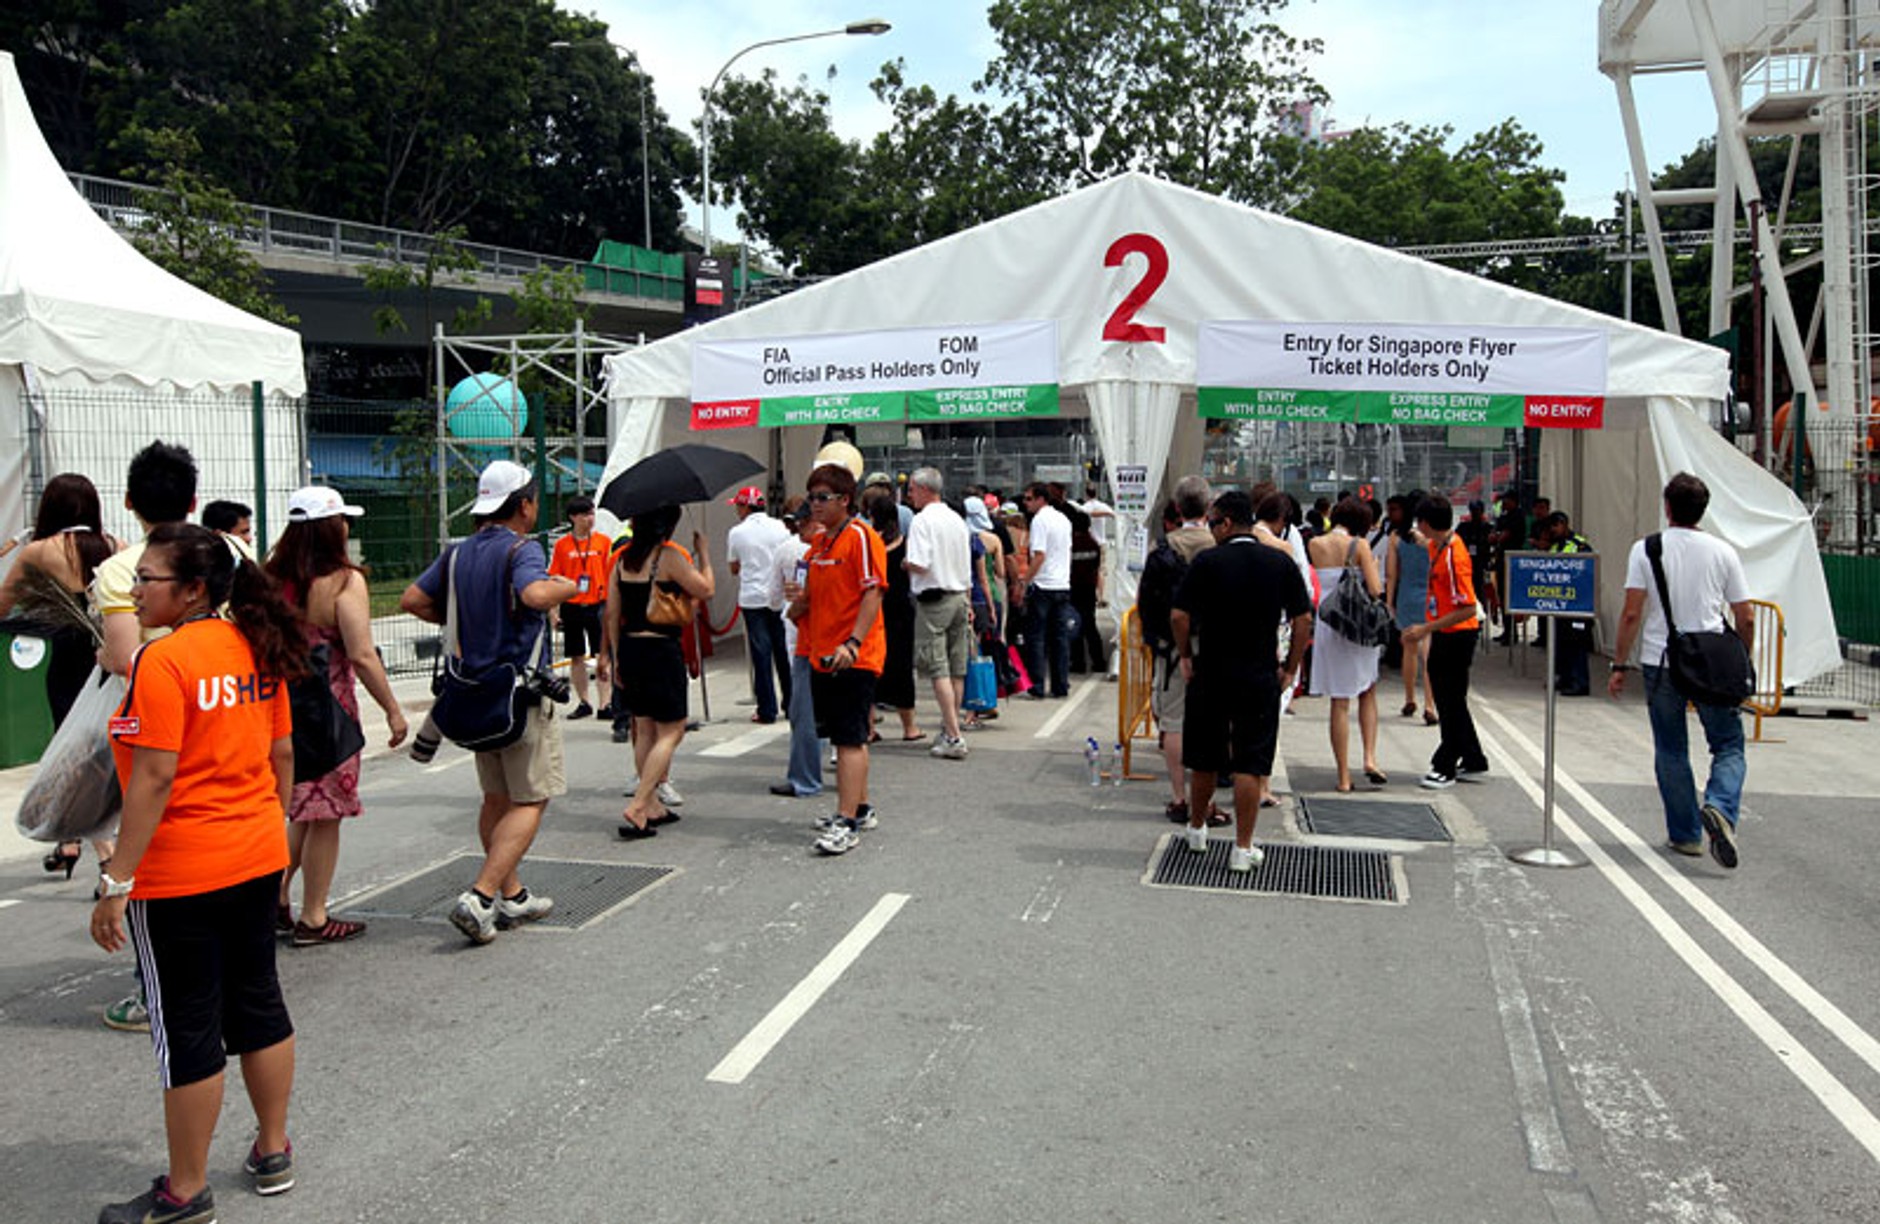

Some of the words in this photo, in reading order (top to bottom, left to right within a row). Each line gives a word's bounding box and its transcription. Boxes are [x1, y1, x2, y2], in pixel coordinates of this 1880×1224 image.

[1102, 232, 1169, 344] 2
[763, 347, 791, 364] FIA
[939, 336, 979, 354] FOM
[1283, 333, 1332, 356] Entry
[1337, 334, 1363, 352] for
[1368, 335, 1463, 358] Singapore
[1469, 337, 1517, 359] Flyer
[763, 366, 821, 385] Official
[825, 364, 865, 382] Pass
[871, 361, 936, 379] Holders
[940, 358, 981, 377] Only
[1308, 356, 1362, 375] Ticket
[1367, 357, 1439, 377] Holders
[1445, 359, 1489, 382] Only
[936, 389, 988, 402] EXPRESS
[991, 387, 1028, 399] ENTRY
[1257, 390, 1296, 402] ENTRY
[1389, 394, 1447, 406] EXPRESS
[1450, 395, 1490, 407] ENTRY
[814, 396, 851, 408] ENTRY
[940, 403, 956, 415] NO
[959, 402, 984, 414] BAG
[986, 400, 1026, 413] CHECK
[698, 407, 713, 420] NO
[715, 405, 752, 419] ENTRY
[785, 410, 812, 422] WITH
[815, 409, 839, 421] BAG
[841, 407, 880, 419] CHECK
[1225, 403, 1253, 415] WITH
[1257, 404, 1283, 416] BAG
[1285, 405, 1328, 417] CHECK
[1392, 409, 1410, 420] NO
[1414, 409, 1440, 420] BAG
[1443, 409, 1487, 422] CHECK
[1529, 404, 1548, 416] NO
[1551, 404, 1593, 418] ENTRY
[1518, 558, 1585, 570] SINGAPORE
[1533, 571, 1571, 584] FLYER
[1536, 599, 1567, 610] ONLY
